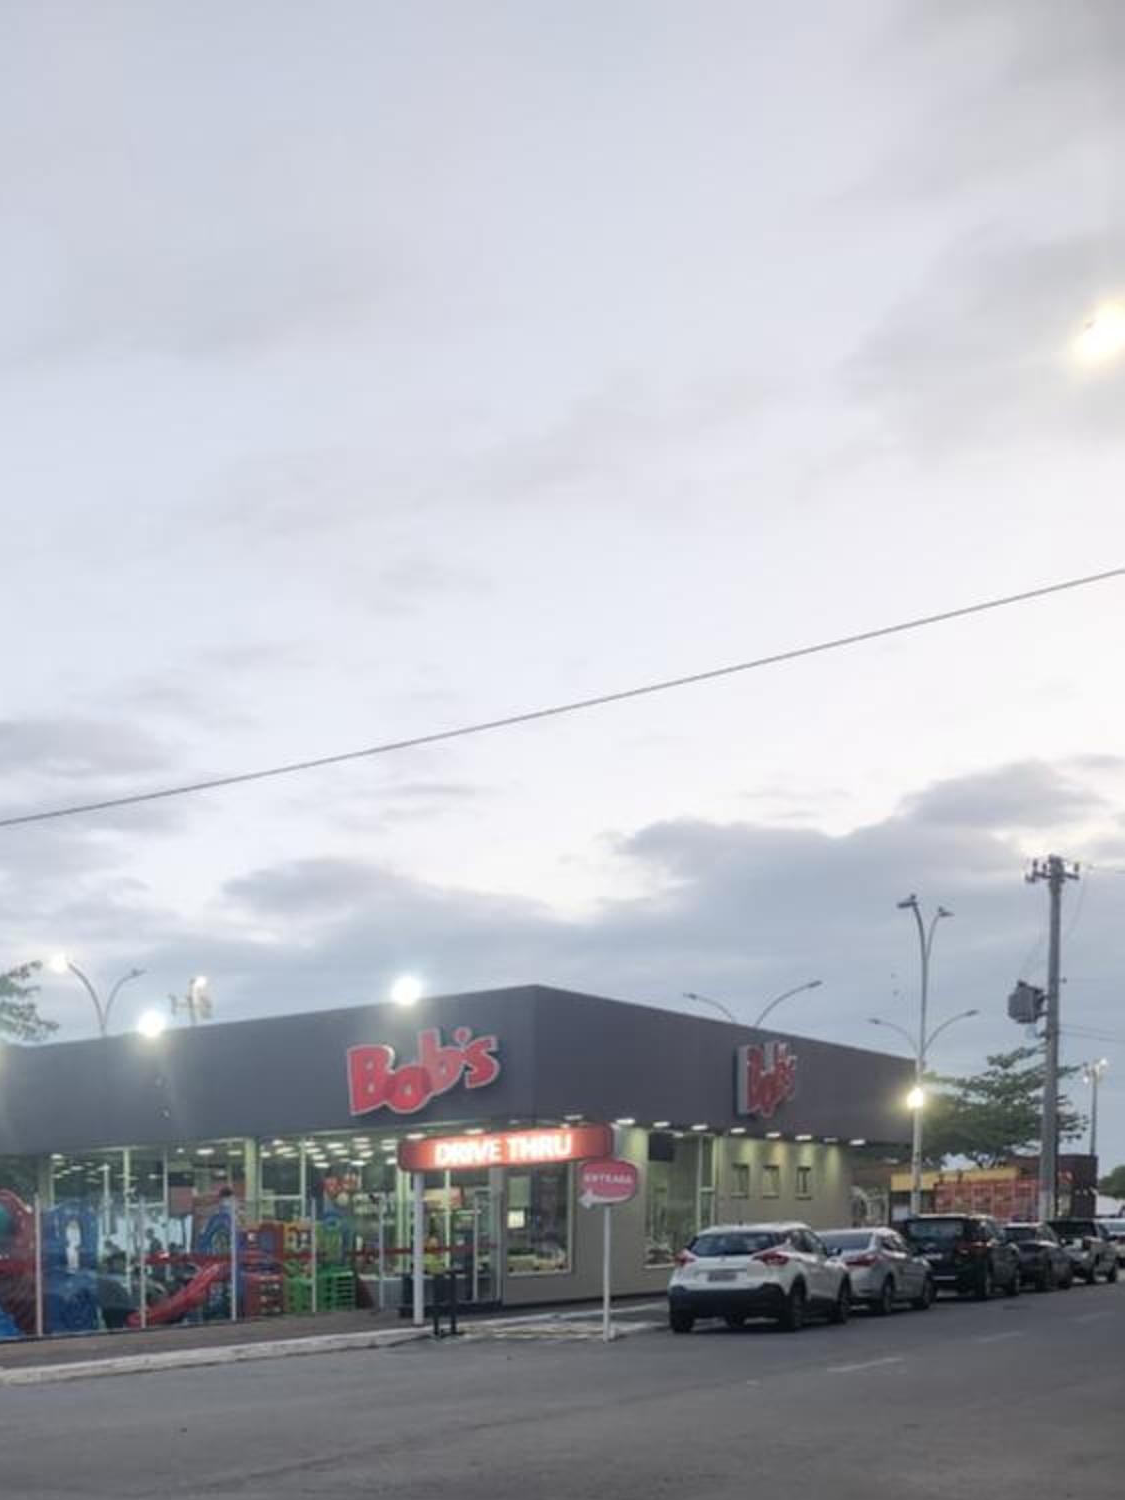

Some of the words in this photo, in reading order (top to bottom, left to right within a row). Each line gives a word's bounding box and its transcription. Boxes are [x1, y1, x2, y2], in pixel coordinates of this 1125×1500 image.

[347, 1027, 500, 1116] Bob's
[434, 1139, 502, 1167] DRIVE
[506, 1133, 572, 1162] THRU
